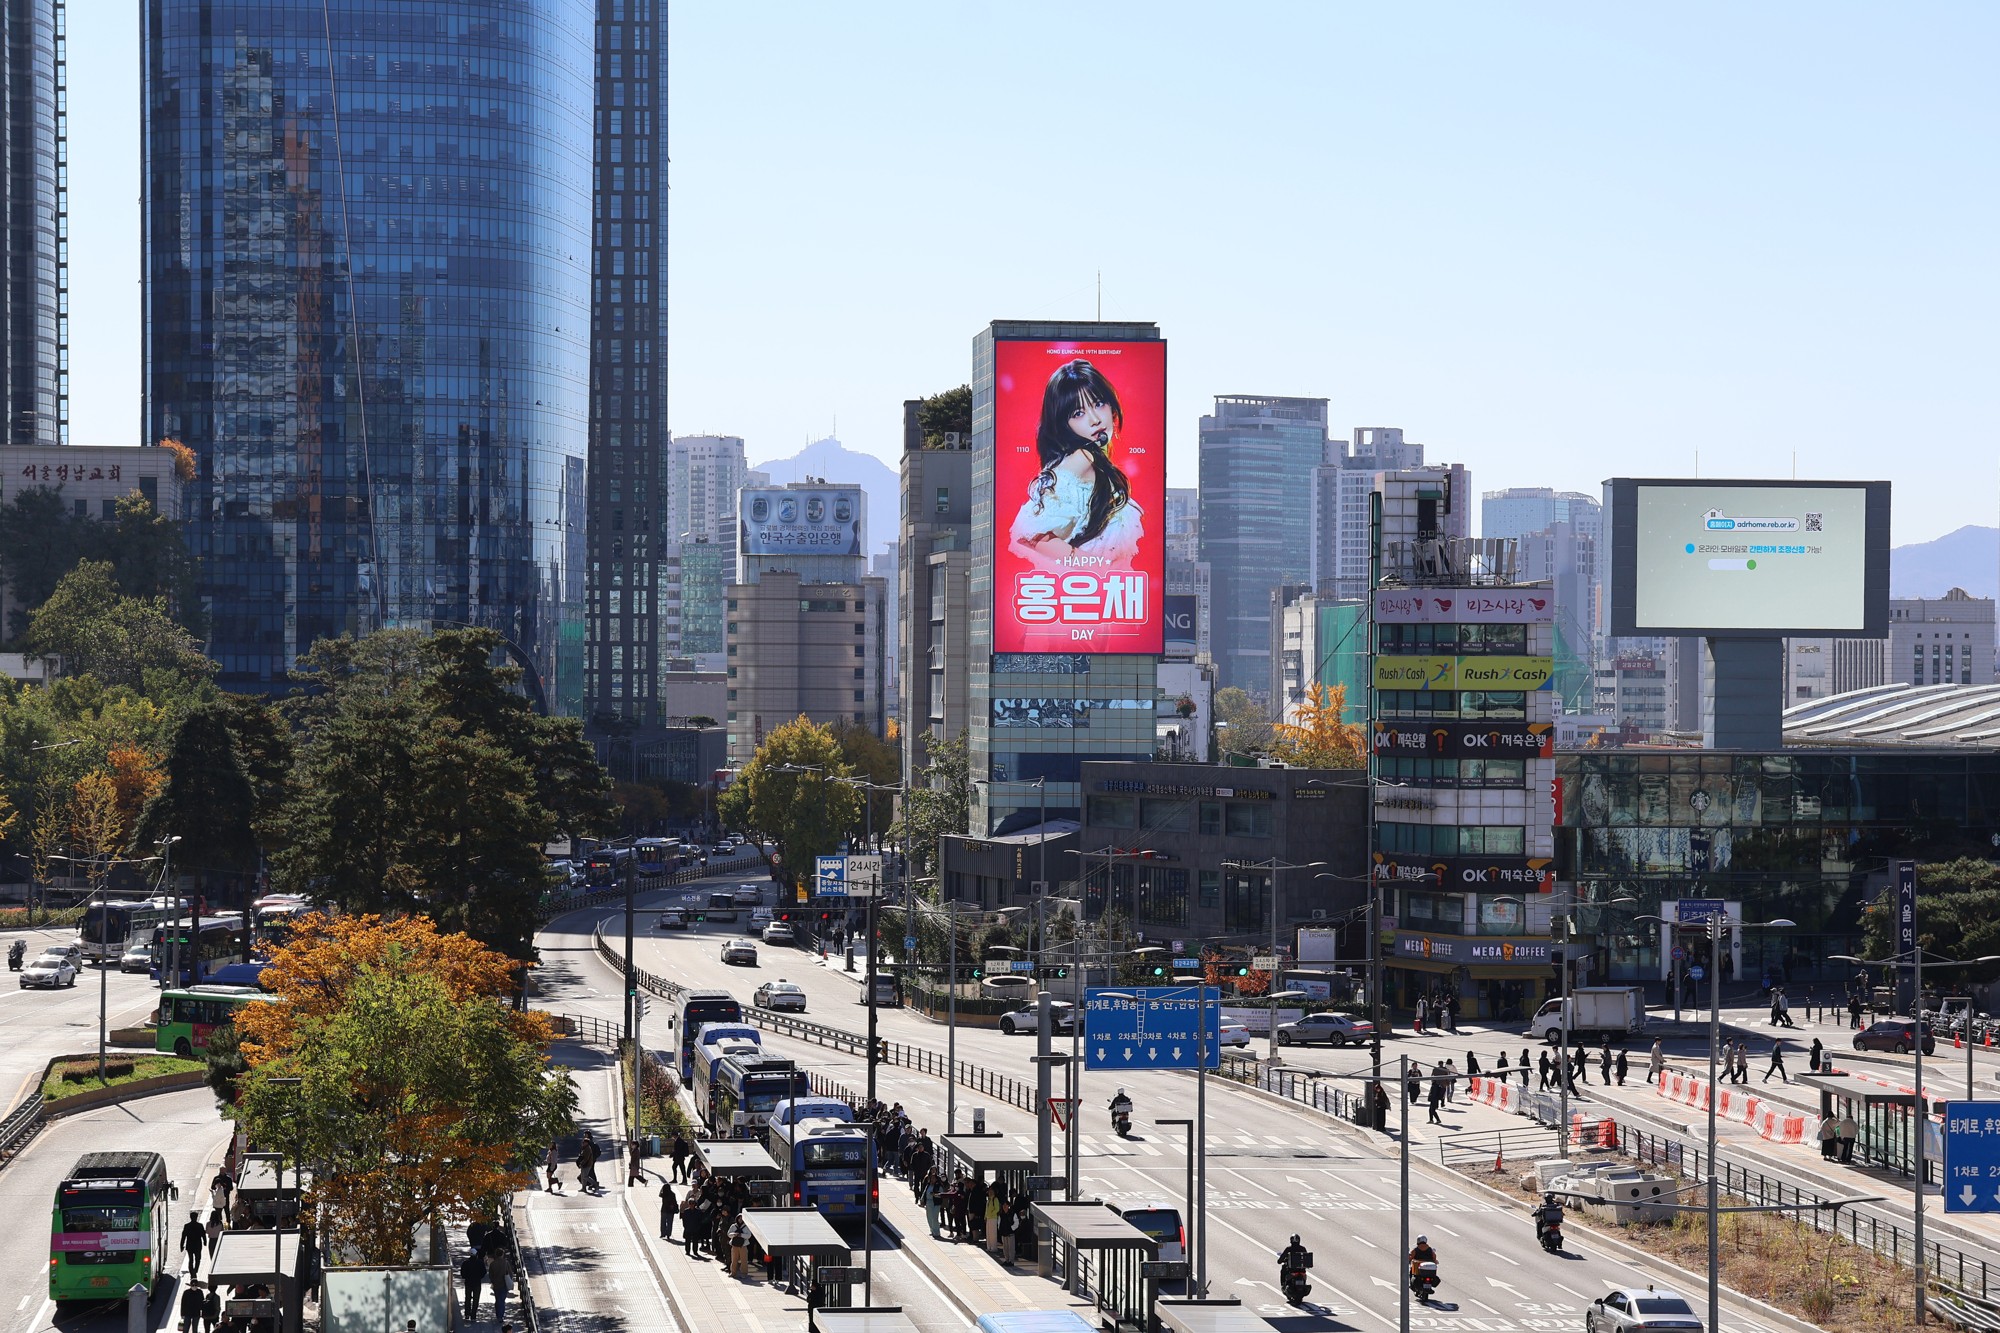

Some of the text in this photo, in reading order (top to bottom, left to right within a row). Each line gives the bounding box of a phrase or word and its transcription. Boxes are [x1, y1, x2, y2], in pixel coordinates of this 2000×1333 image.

[22, 464, 120, 482] 서울성남교회
[1737, 521, 1795, 529] adrhome.reb.or.kr
[760, 533, 841, 545] 한국수출입은행
[1064, 556, 1104, 567] HAPPY
[1017, 574, 1144, 621] 홍은채
[1381, 598, 1411, 615] 미즈사랑
[1467, 599, 1525, 614] 미즈사랑
[1165, 613, 1191, 629] NG
[1071, 629, 1094, 640] DAY
[1379, 668, 1425, 680] Rush Cash
[1465, 668, 1547, 680] Rush Cash
[1375, 732, 1426, 748] OK 저축은행
[1463, 733, 1547, 747] OK 저축은행
[850, 861, 880, 871] 24시간
[1463, 869, 1546, 882] OK 저축은행
[1902, 882, 1912, 945] 서울역
[1405, 939, 1424, 952] MEGA
[1431, 942, 1453, 955] COFFEE
[1472, 947, 1502, 957] MEGA
[1515, 946, 1545, 957] COFFEE
[1118, 1032, 1137, 1040] 2차로
[1143, 1032, 1162, 1040] 3차로
[1168, 1032, 1187, 1040] 4차로
[1192, 1031, 1214, 1040] 5로
[737, 1126, 742, 1134] 5
[845, 1152, 859, 1160] 503
[1953, 1166, 1979, 1177] 1차로
[114, 1219, 132, 1227] 7017
